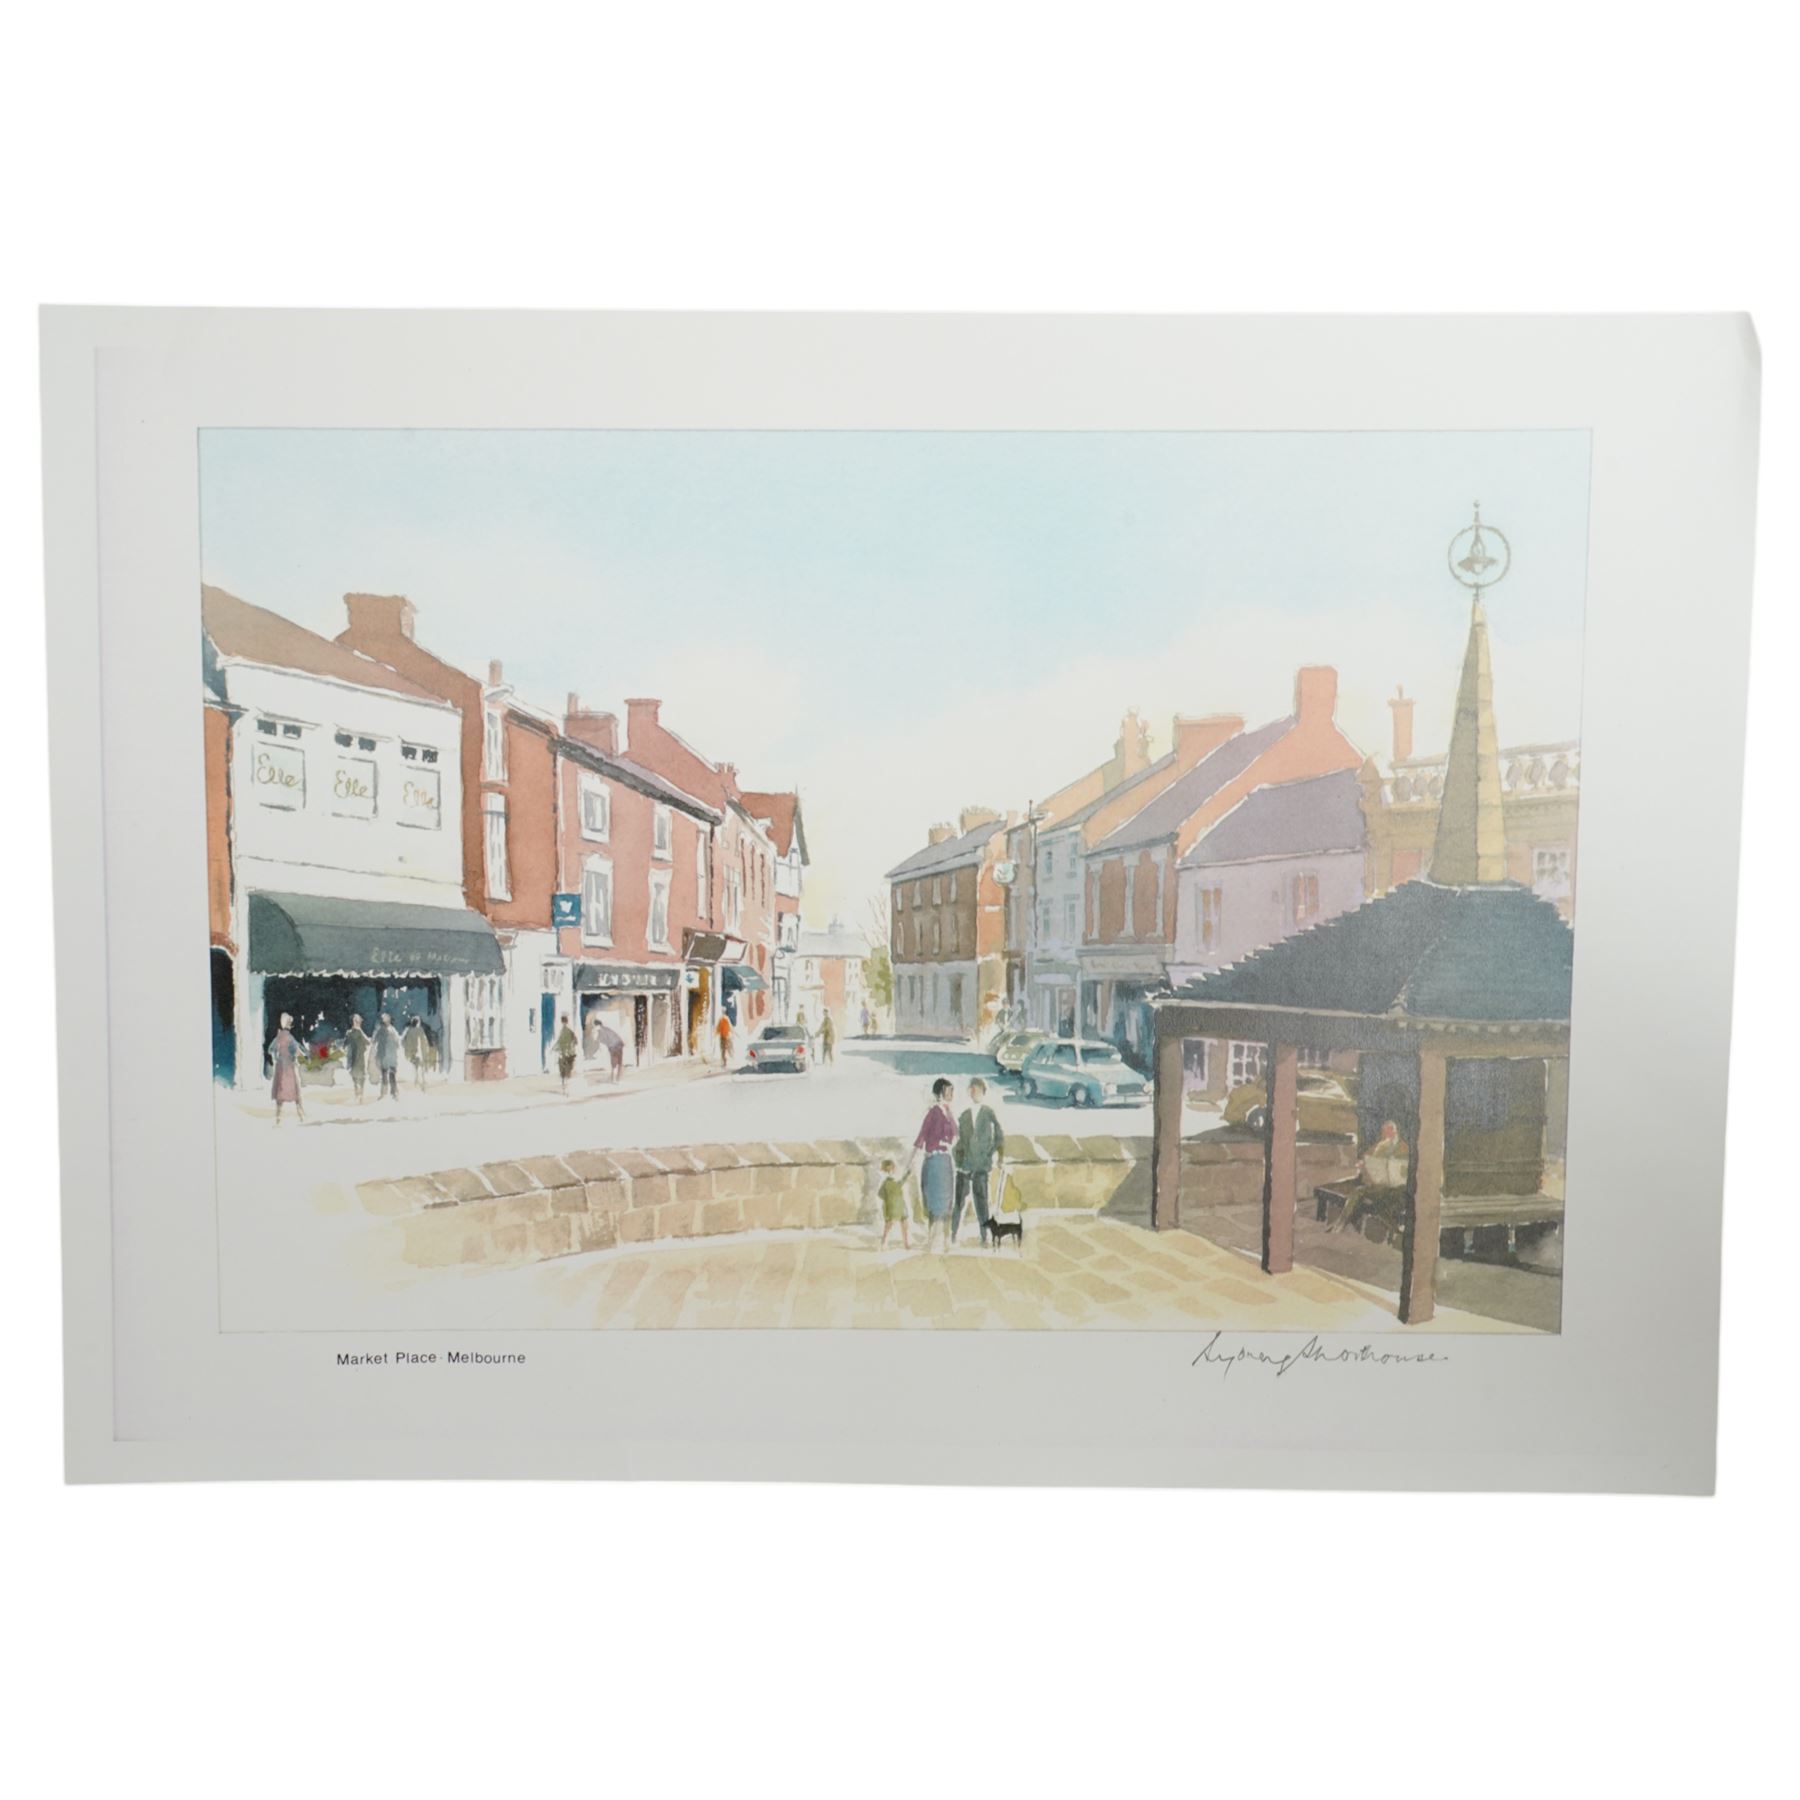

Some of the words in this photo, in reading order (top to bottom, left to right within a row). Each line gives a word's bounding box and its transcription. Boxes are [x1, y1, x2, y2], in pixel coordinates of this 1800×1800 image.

[256, 753, 299, 788] Elle
[333, 769, 369, 799] Elle
[336, 1352, 388, 1366] Market
[395, 1352, 438, 1364] Place
[447, 1351, 527, 1364] Melbourne
